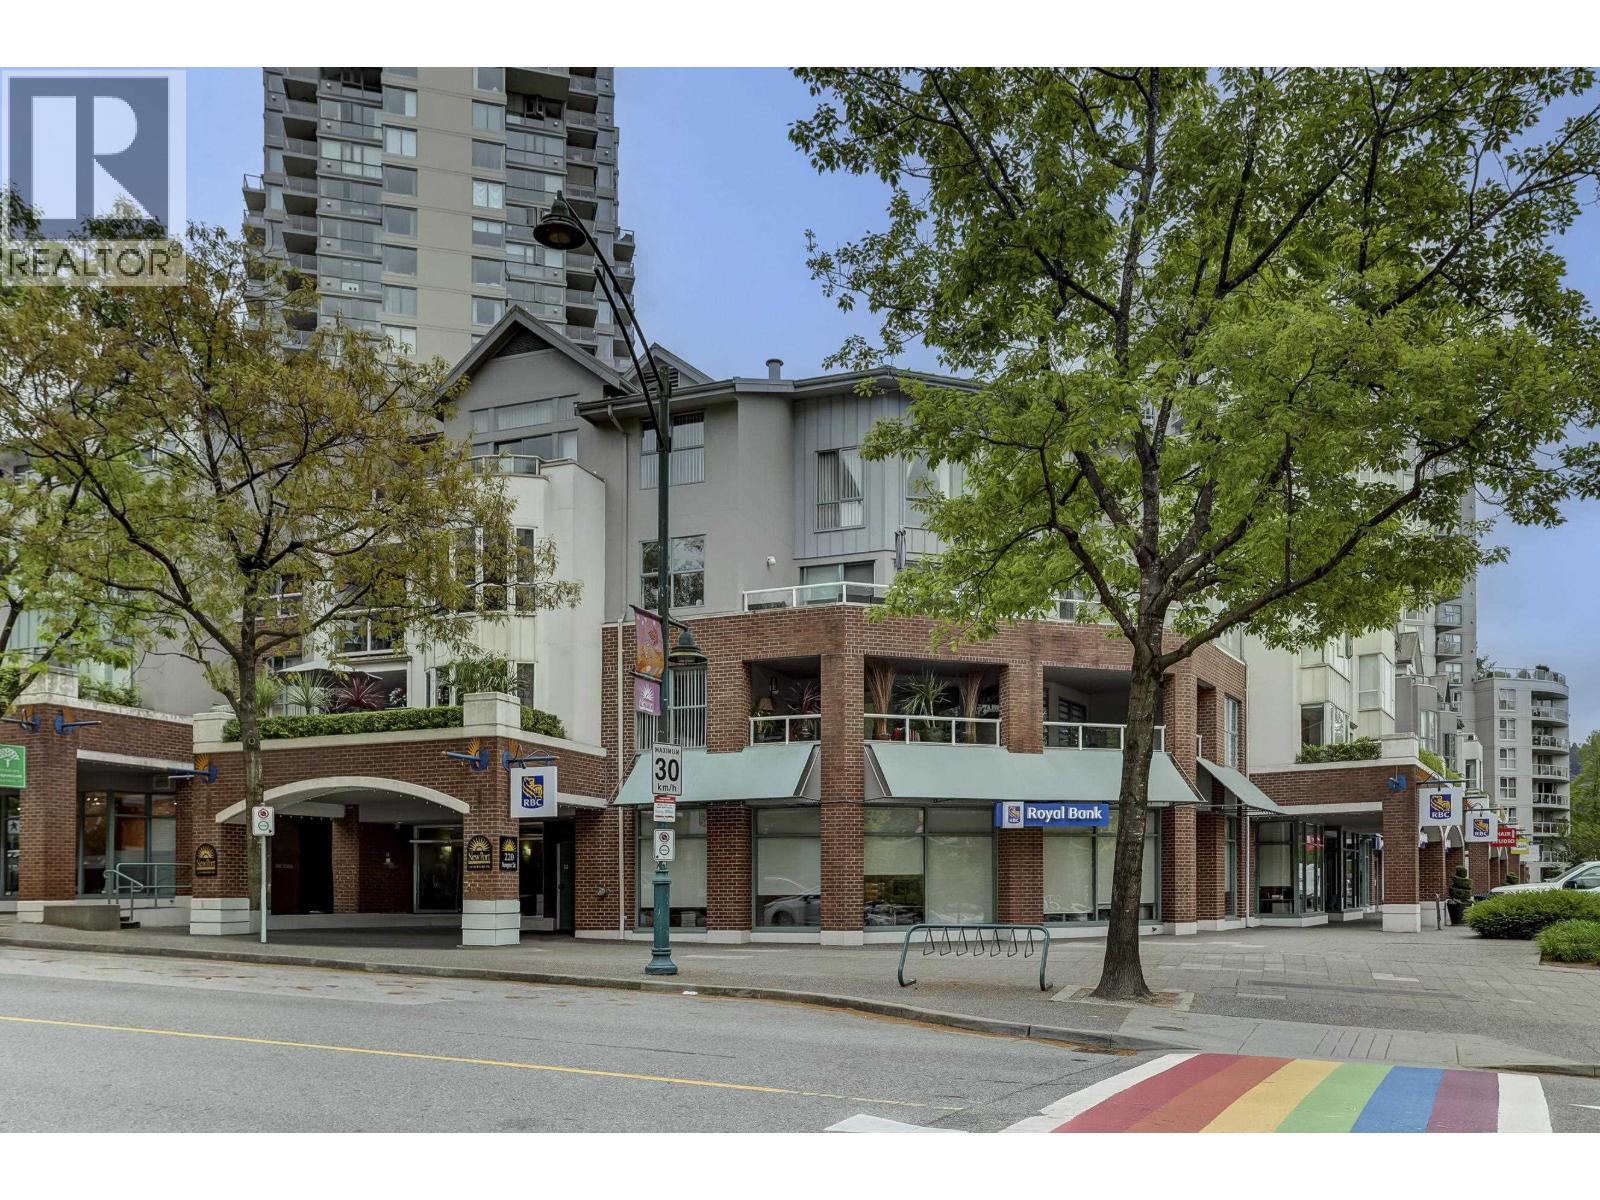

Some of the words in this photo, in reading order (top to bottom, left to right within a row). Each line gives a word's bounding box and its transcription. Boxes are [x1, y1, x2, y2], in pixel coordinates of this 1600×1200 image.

[655, 747, 680, 755] MAXIMUM
[655, 757, 679, 782] 30
[657, 782, 677, 792] km/h
[1028, 806, 1064, 823] Royal
[1068, 806, 1102, 819] Bank
[504, 852, 515, 862] 220
